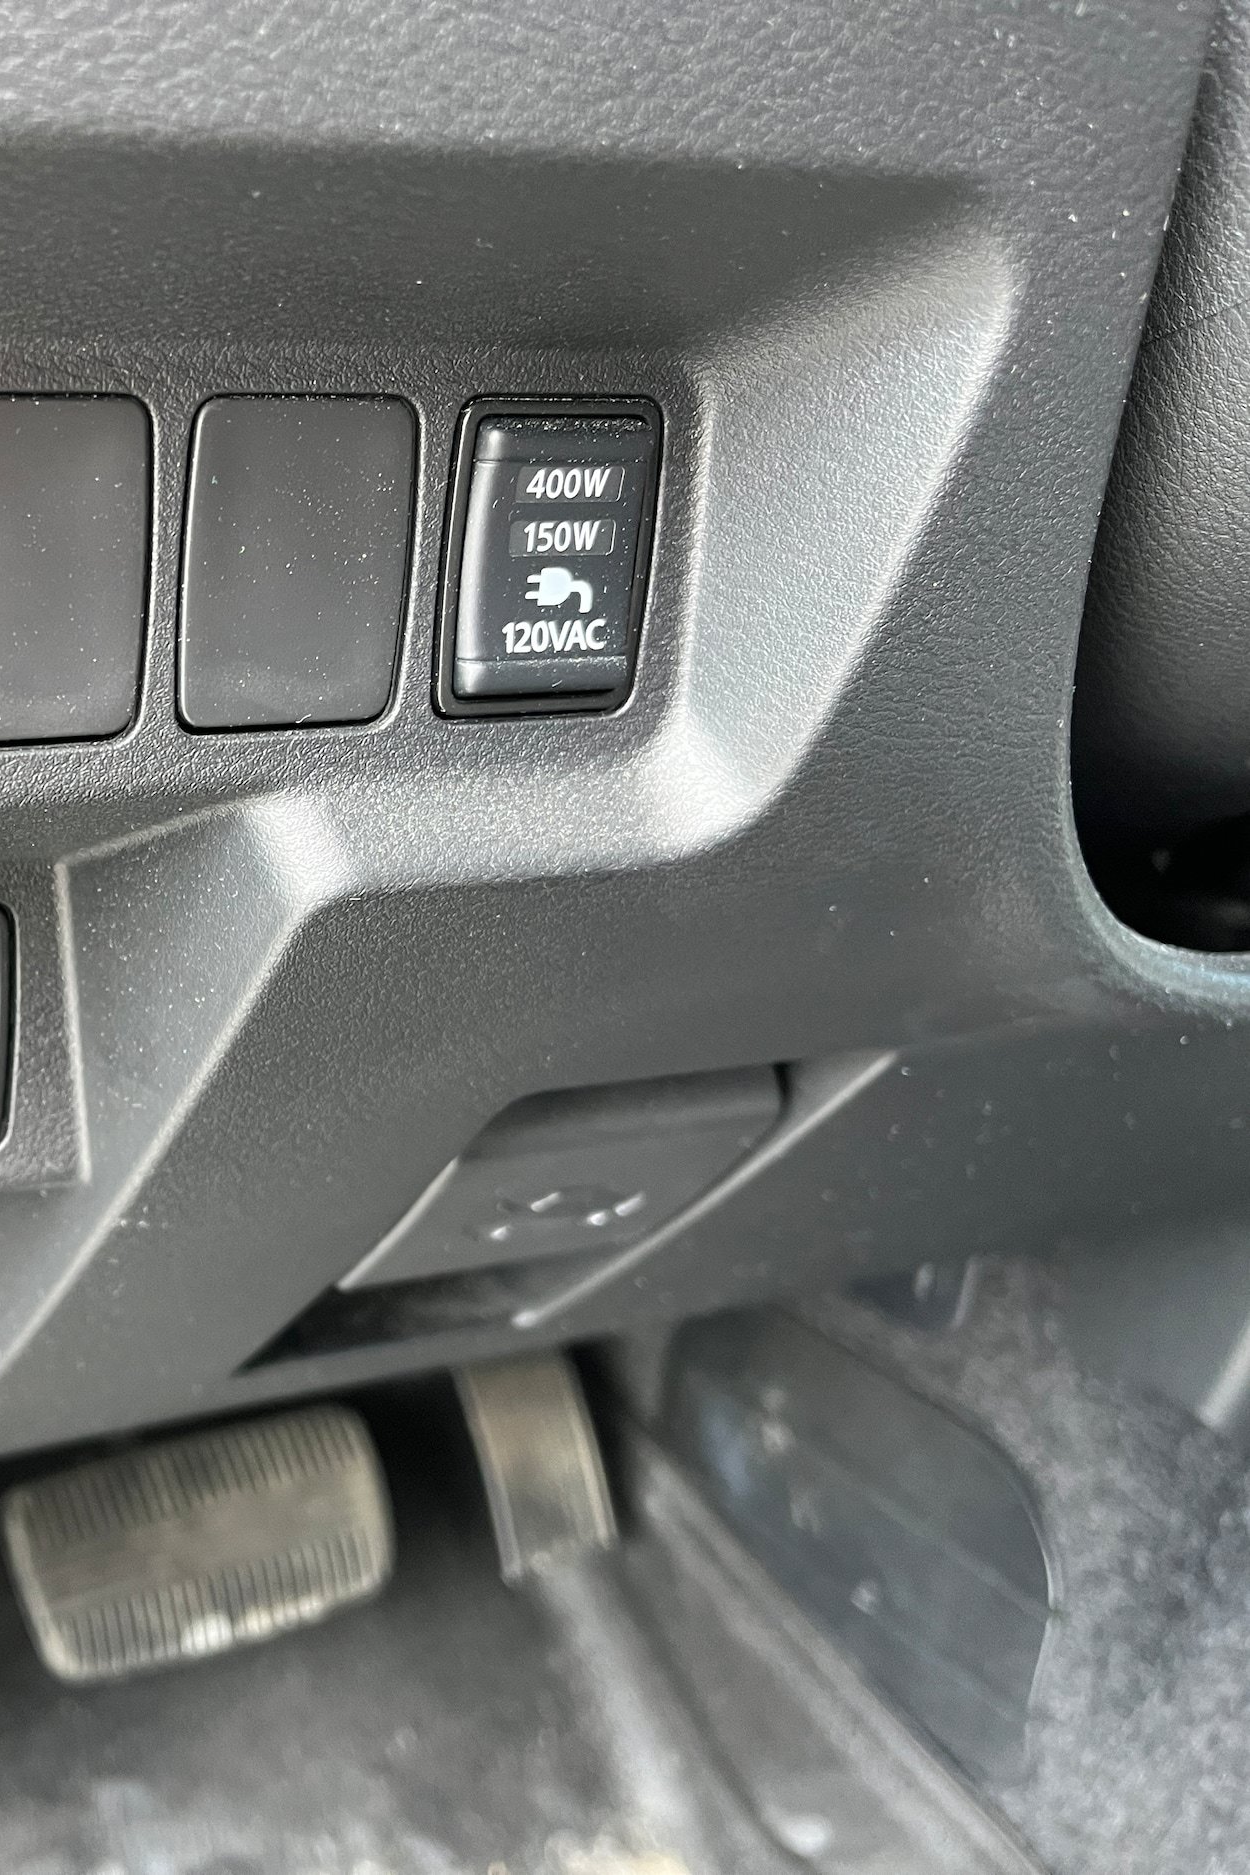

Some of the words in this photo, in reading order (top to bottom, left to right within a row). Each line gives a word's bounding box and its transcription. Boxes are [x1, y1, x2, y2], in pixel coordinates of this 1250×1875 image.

[526, 467, 611, 499] 400W
[523, 520, 600, 552] 150W
[502, 618, 606, 654] 120VAC
